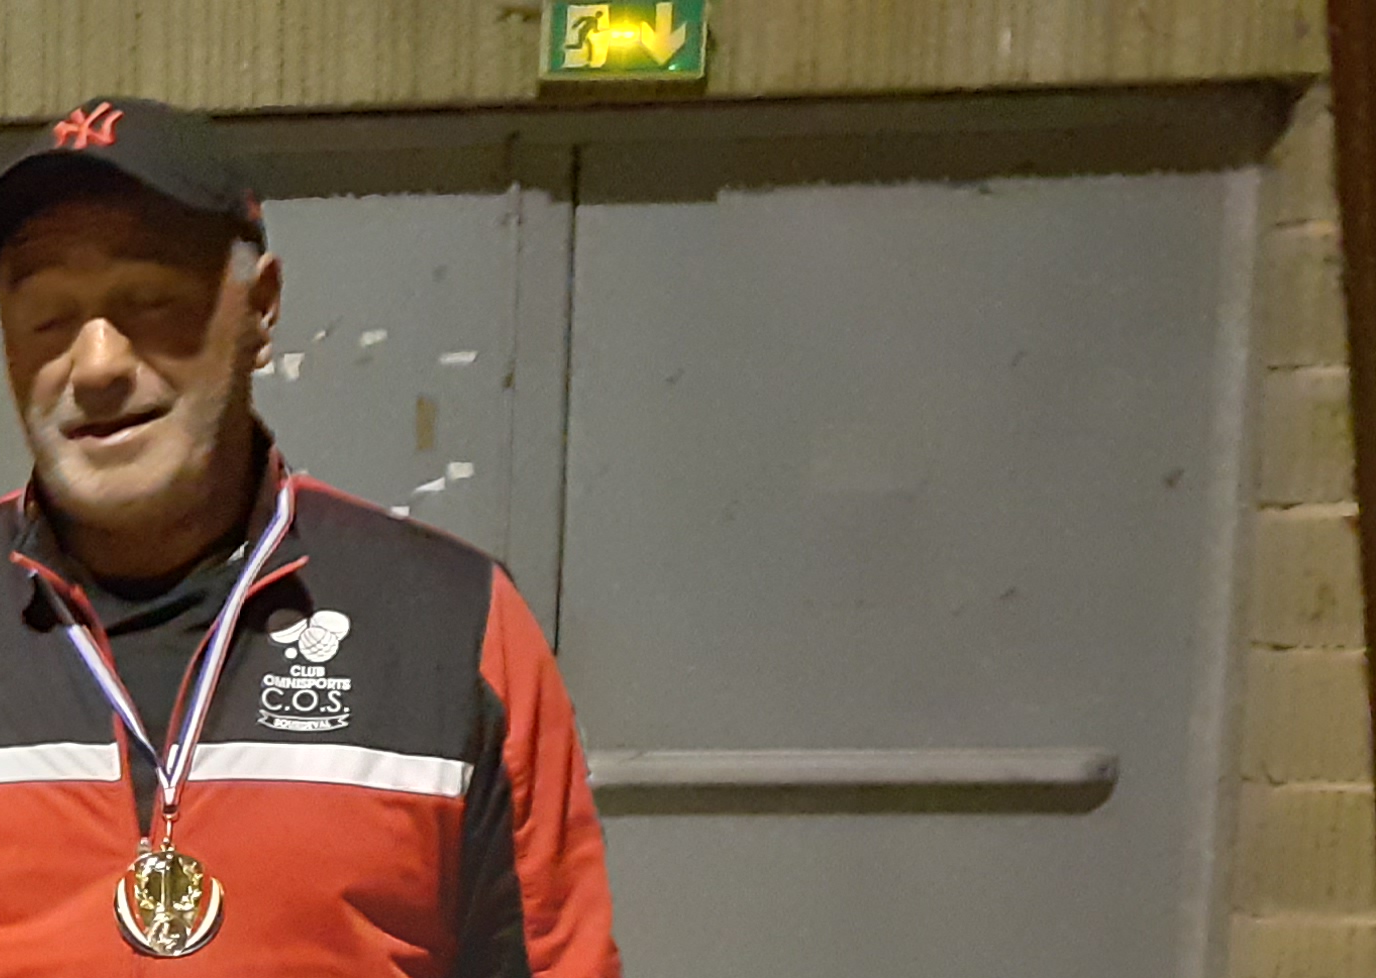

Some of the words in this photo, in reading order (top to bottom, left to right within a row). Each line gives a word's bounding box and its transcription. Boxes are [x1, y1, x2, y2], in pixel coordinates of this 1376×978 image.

[289, 664, 327, 677] CLUB
[262, 673, 352, 691] OMNISPORTS
[261, 686, 351, 712] C.O.S.
